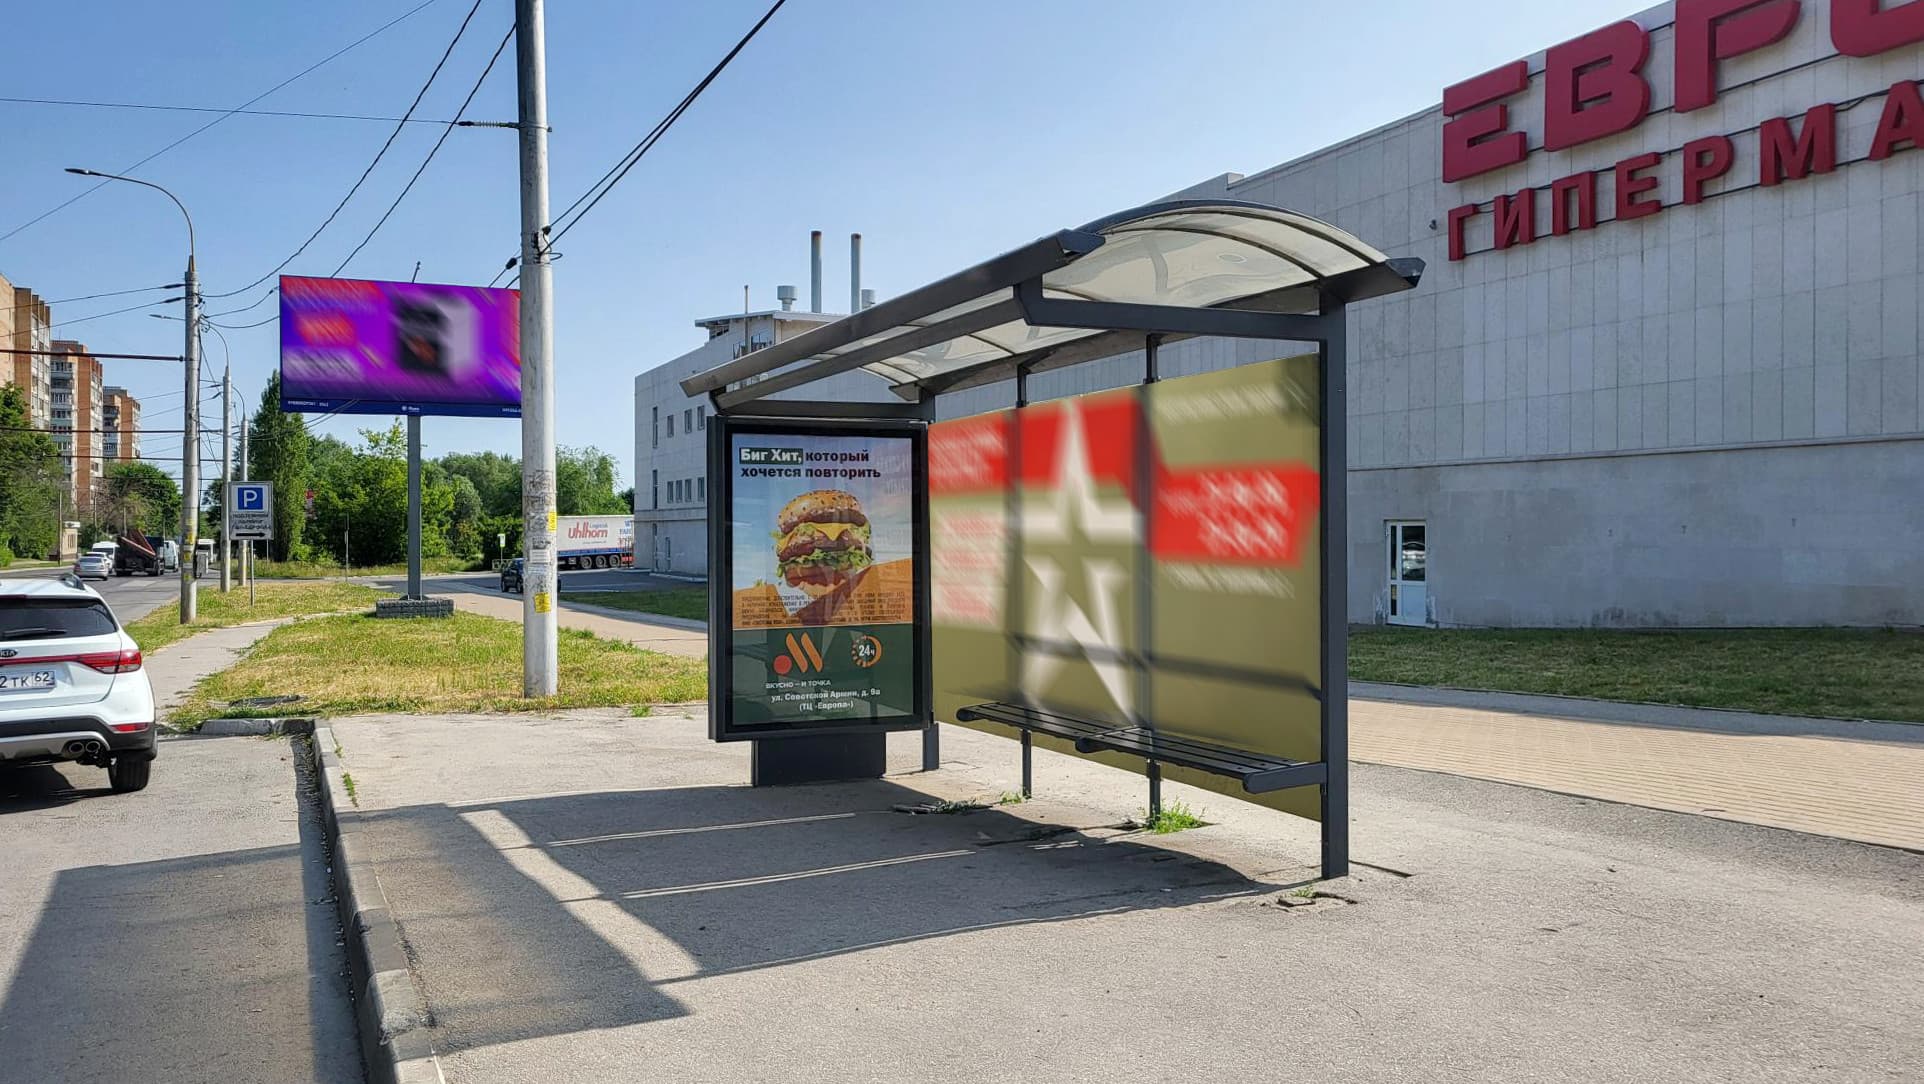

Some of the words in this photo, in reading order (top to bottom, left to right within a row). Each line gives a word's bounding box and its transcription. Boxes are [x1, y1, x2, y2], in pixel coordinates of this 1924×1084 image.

[1448, 79, 1924, 261] ГИПЕРМА
[740, 448, 766, 461] Биг
[771, 449, 802, 464] Хит,
[806, 449, 869, 464] который
[741, 467, 801, 477] хочется
[805, 468, 881, 480] повторить
[243, 489, 258, 508] P
[35, 672, 50, 682] 62
[765, 681, 794, 689] ВКУСНО
[807, 679, 831, 687] ТОЧКА
[771, 694, 783, 703] ул.
[784, 690, 828, 701] Советской
